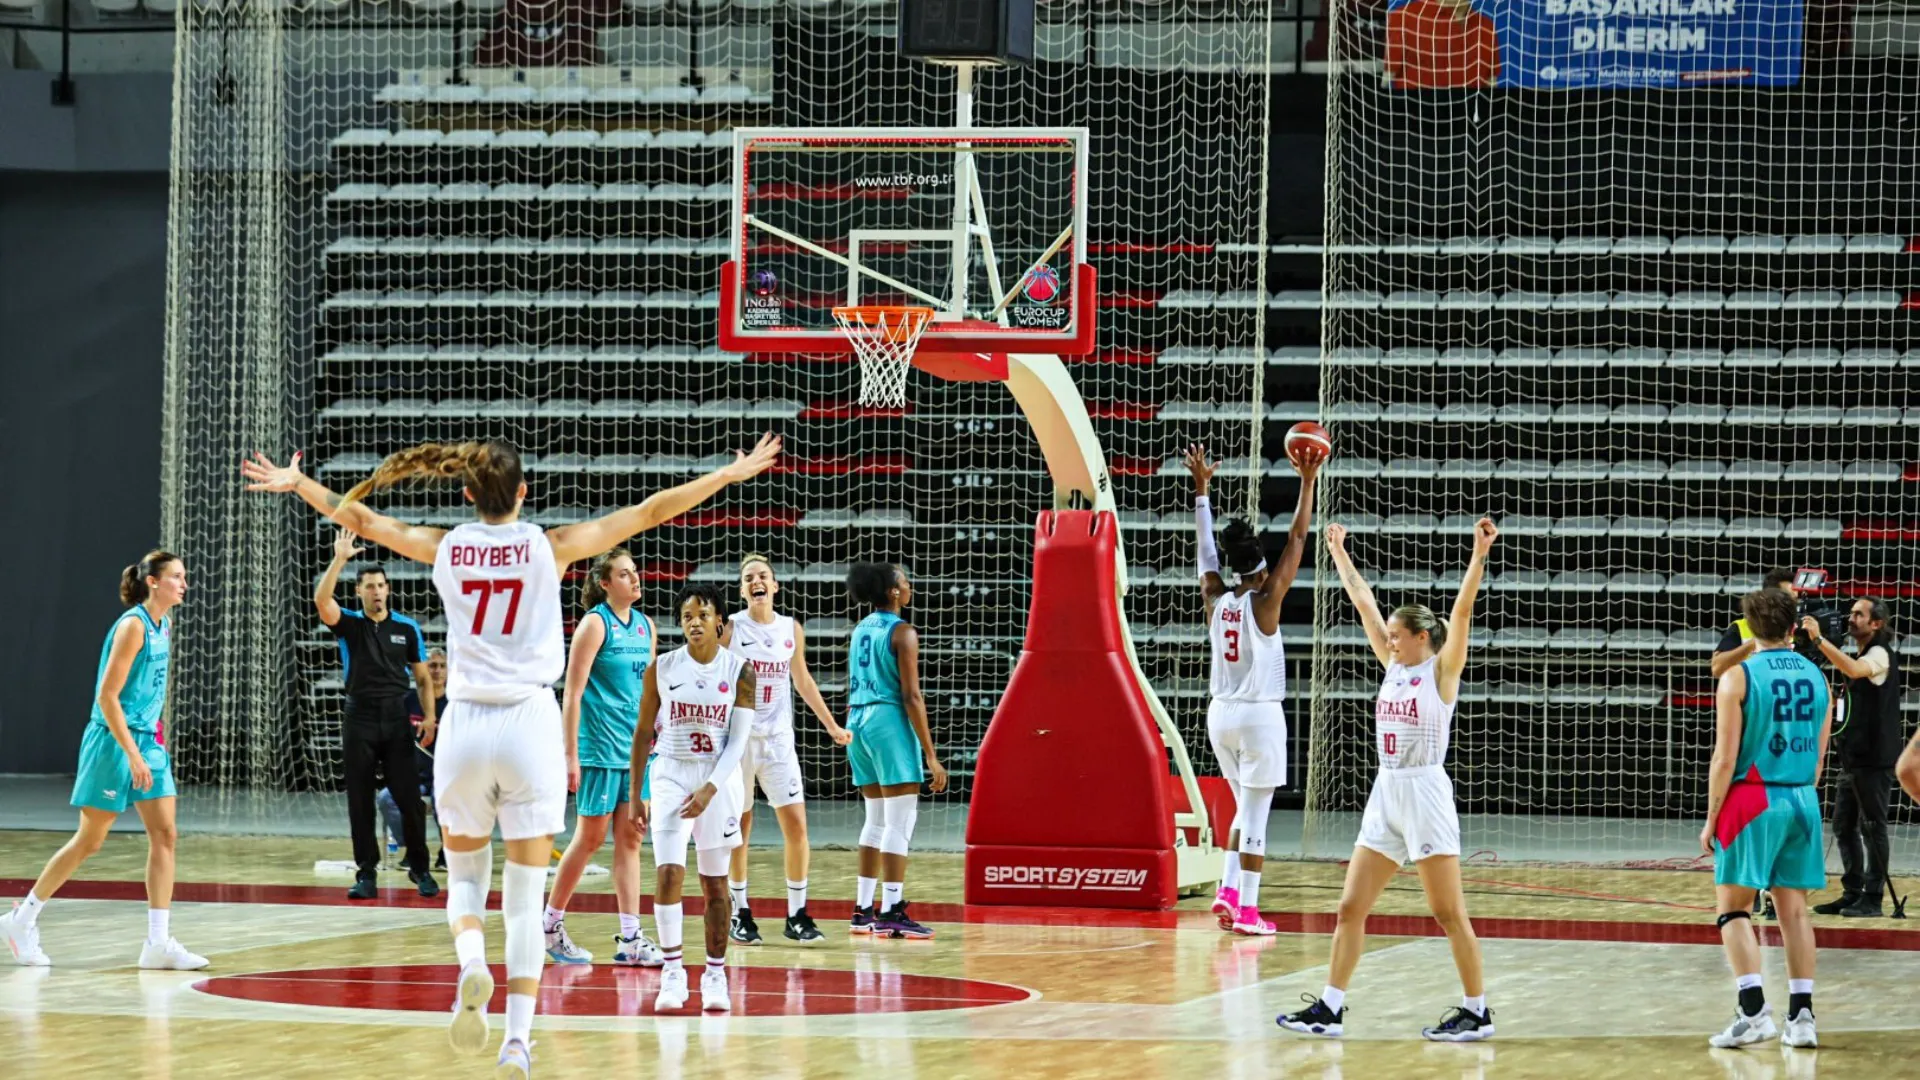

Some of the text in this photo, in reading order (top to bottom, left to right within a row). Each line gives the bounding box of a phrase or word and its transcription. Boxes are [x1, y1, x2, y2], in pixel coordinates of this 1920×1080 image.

[1573, 20, 1706, 52] DİLERİM
[855, 173, 954, 187] www.tbf.org.tr
[745, 298, 768, 308] ING
[1014, 307, 1065, 316] EUROCUP
[1018, 317, 1061, 326] WOMEN
[450, 539, 530, 567] BOYBEYİ
[461, 579, 524, 636] 77
[858, 635, 872, 668] 3
[1224, 629, 1239, 662] 3
[632, 661, 647, 680] 42
[763, 685, 773, 704] 11
[1771, 678, 1815, 722] 22
[670, 700, 728, 723] ANTALYA
[689, 732, 714, 754] 33
[1383, 733, 1397, 755] 10
